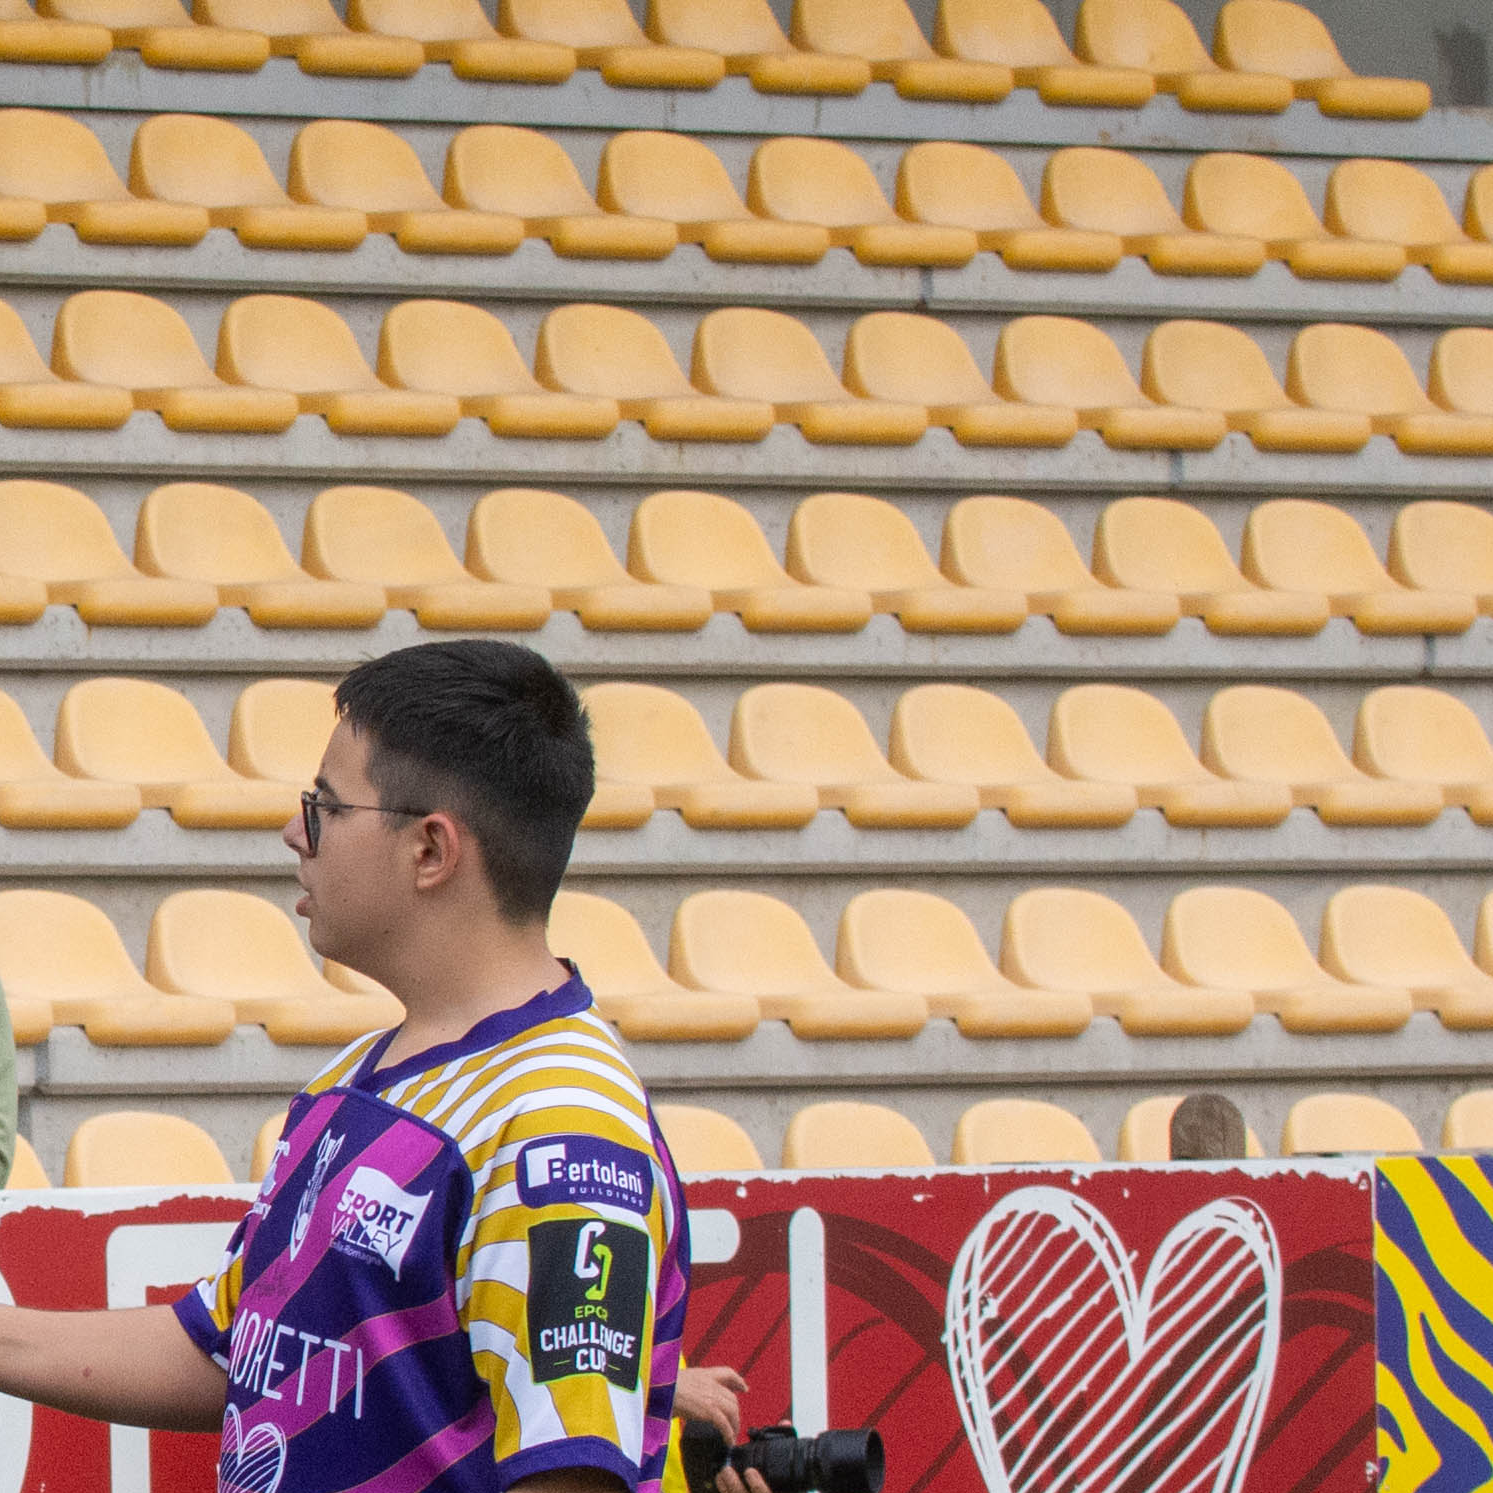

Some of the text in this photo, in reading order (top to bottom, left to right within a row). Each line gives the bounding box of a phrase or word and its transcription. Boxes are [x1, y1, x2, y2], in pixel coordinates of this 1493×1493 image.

[551, 1160, 644, 1195] Bertolani
[568, 1186, 645, 1208] BUILDINGS
[336, 1188, 414, 1235] SPORT
[331, 1212, 403, 1257] VALLEY
[231, 1307, 364, 1420] MORETTI
